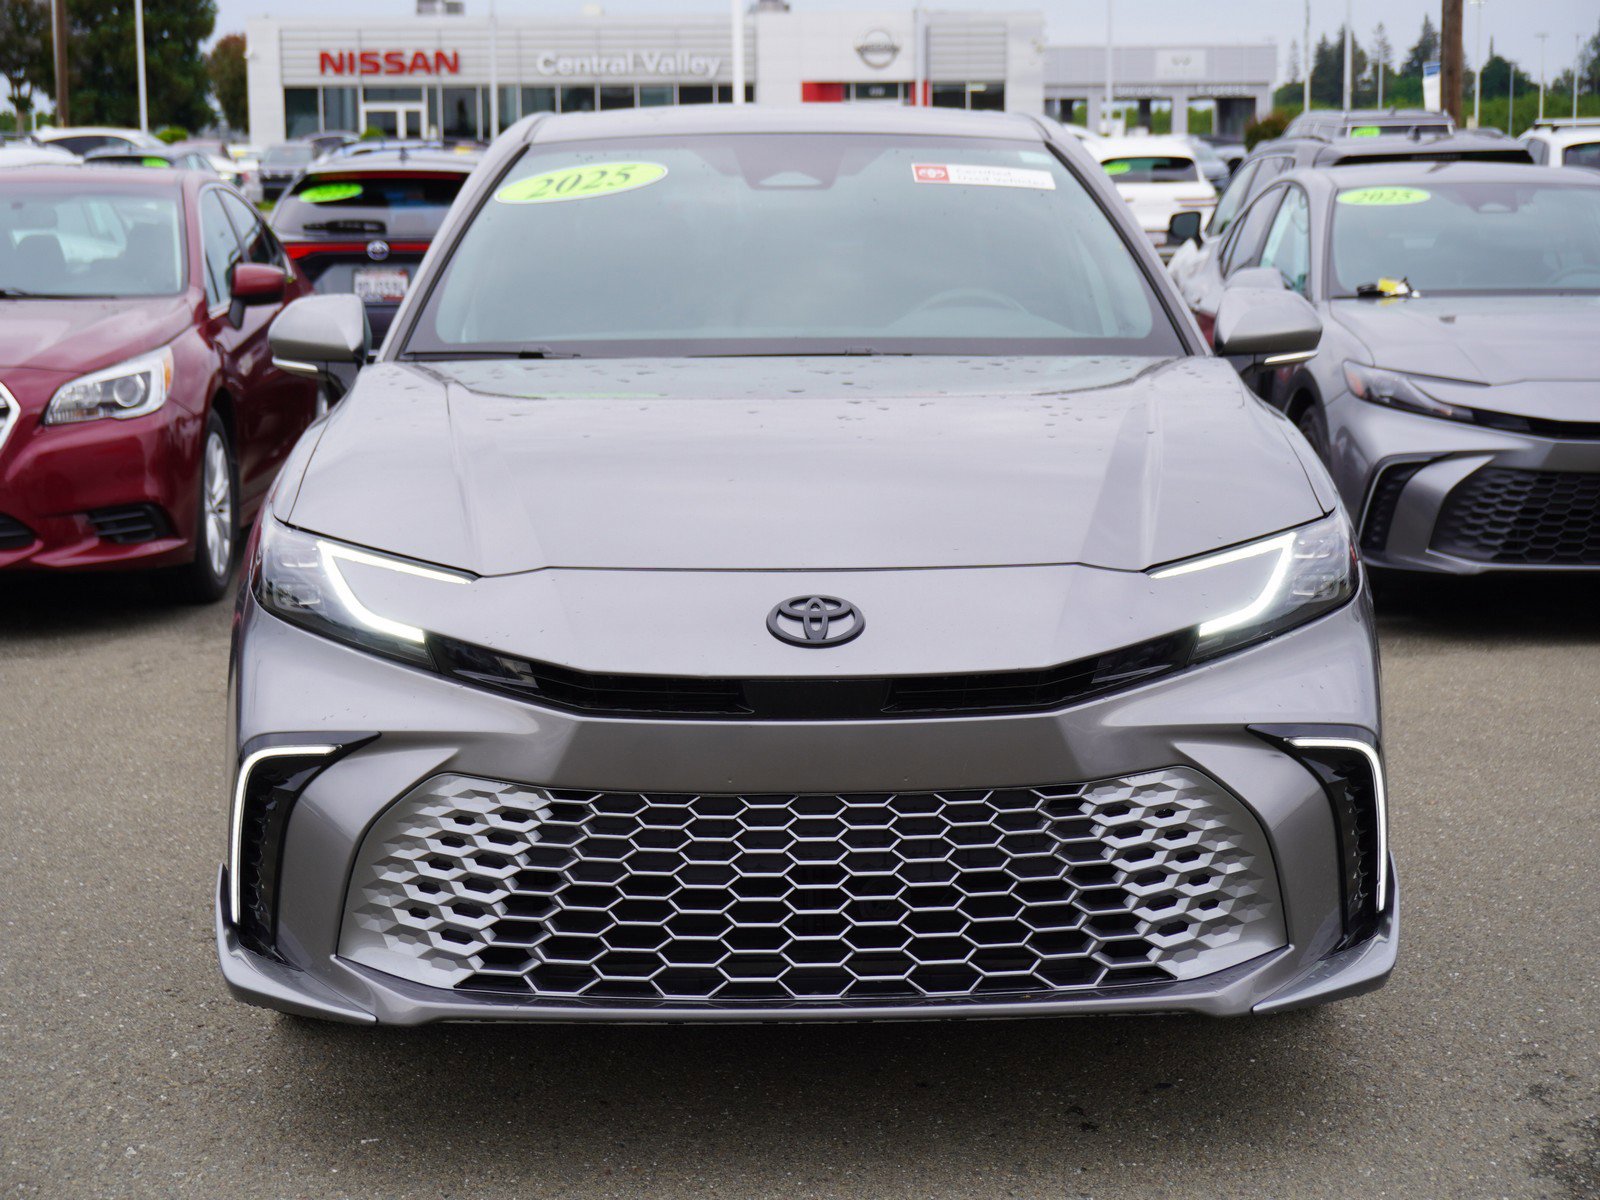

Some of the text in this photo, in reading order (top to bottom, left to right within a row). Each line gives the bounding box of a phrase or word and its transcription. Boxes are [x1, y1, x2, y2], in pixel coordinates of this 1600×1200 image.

[319, 50, 460, 75] NISSAN
[536, 50, 721, 79] Central Valley
[525, 165, 637, 199] 2025
[1353, 190, 1415, 204] 2025
